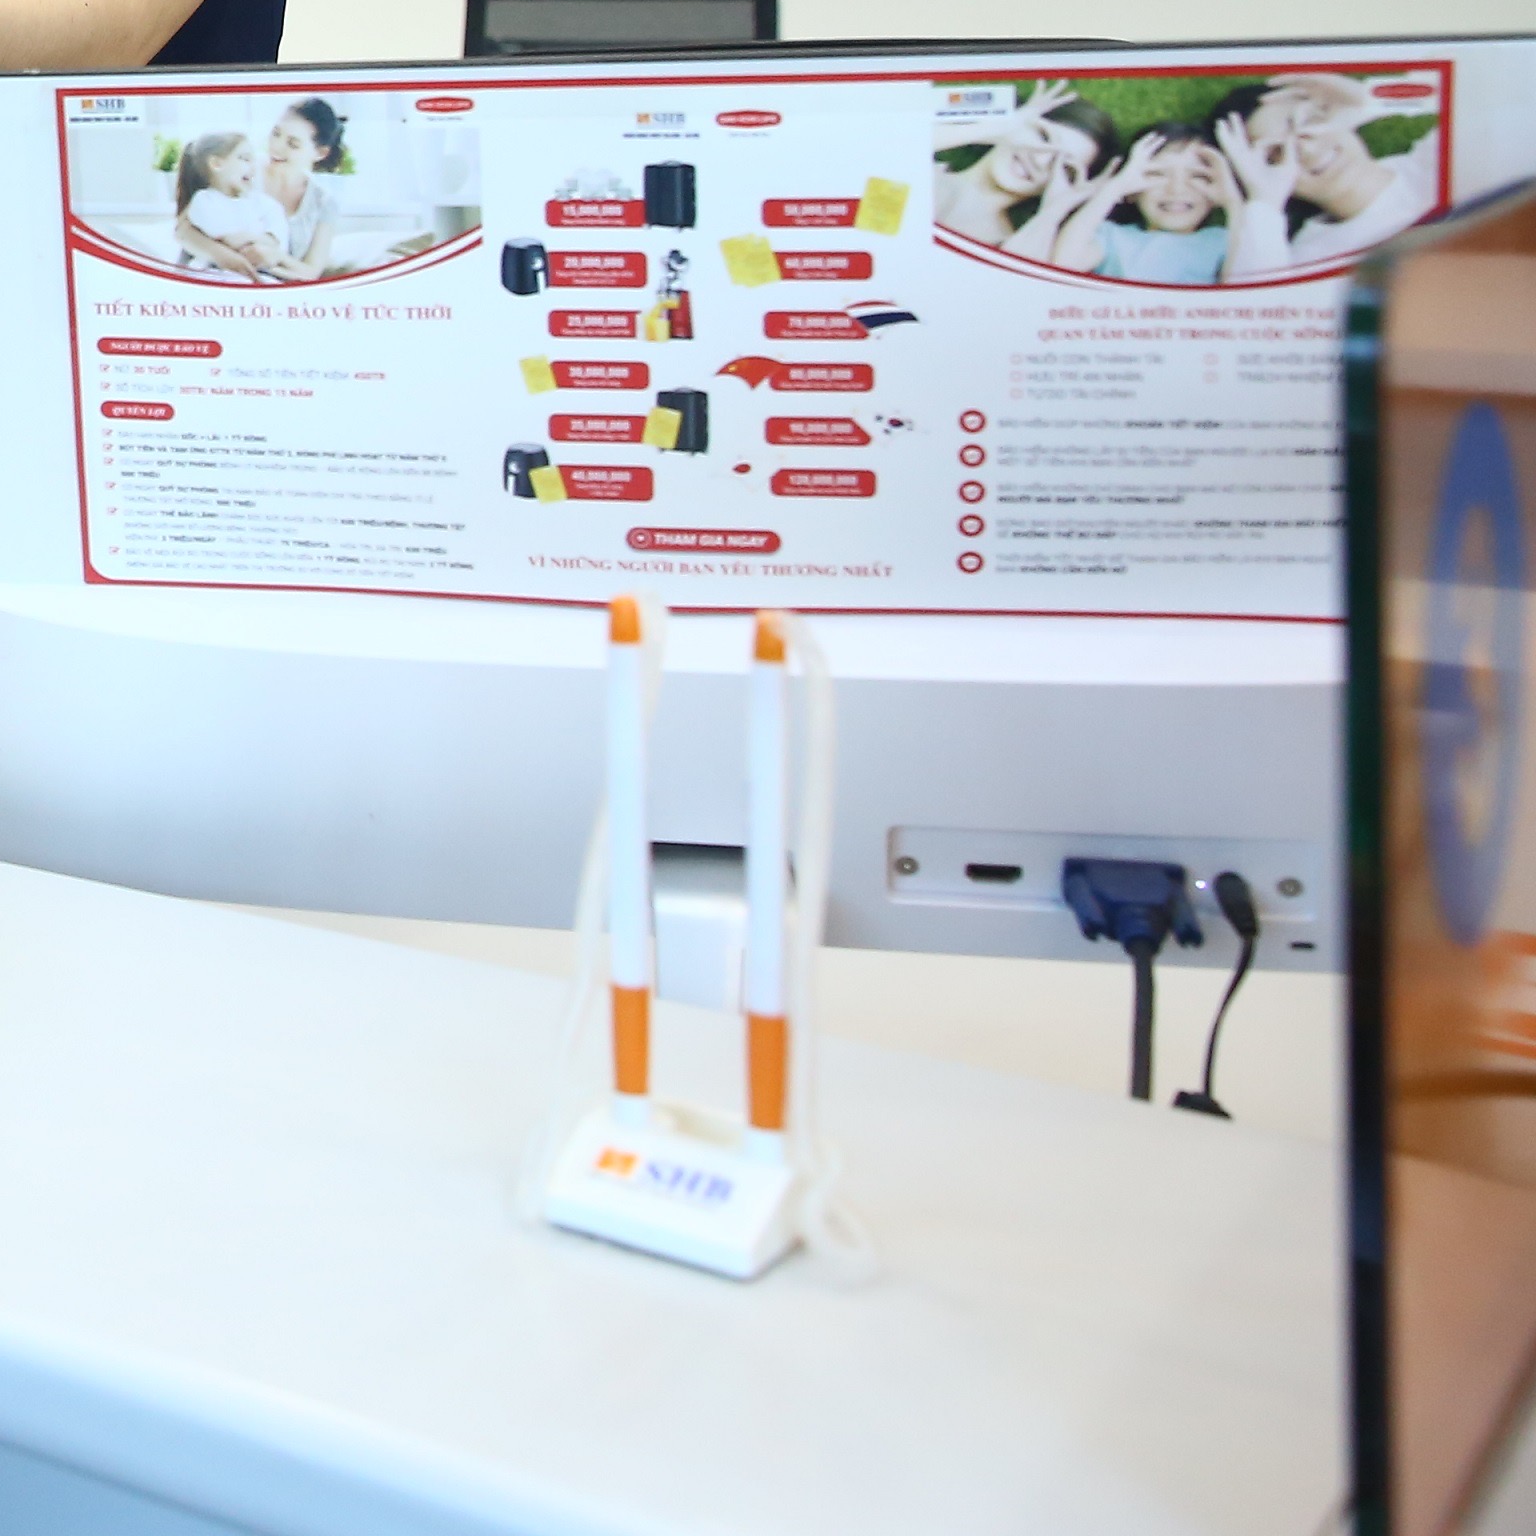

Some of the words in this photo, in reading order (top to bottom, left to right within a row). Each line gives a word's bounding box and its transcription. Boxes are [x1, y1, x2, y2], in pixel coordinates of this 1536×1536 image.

[94, 297, 134, 316] TIẾT
[140, 300, 186, 318] KIỆM
[192, 304, 234, 318] SINH
[654, 533, 697, 546] THAM
[727, 534, 769, 548] NGAY
